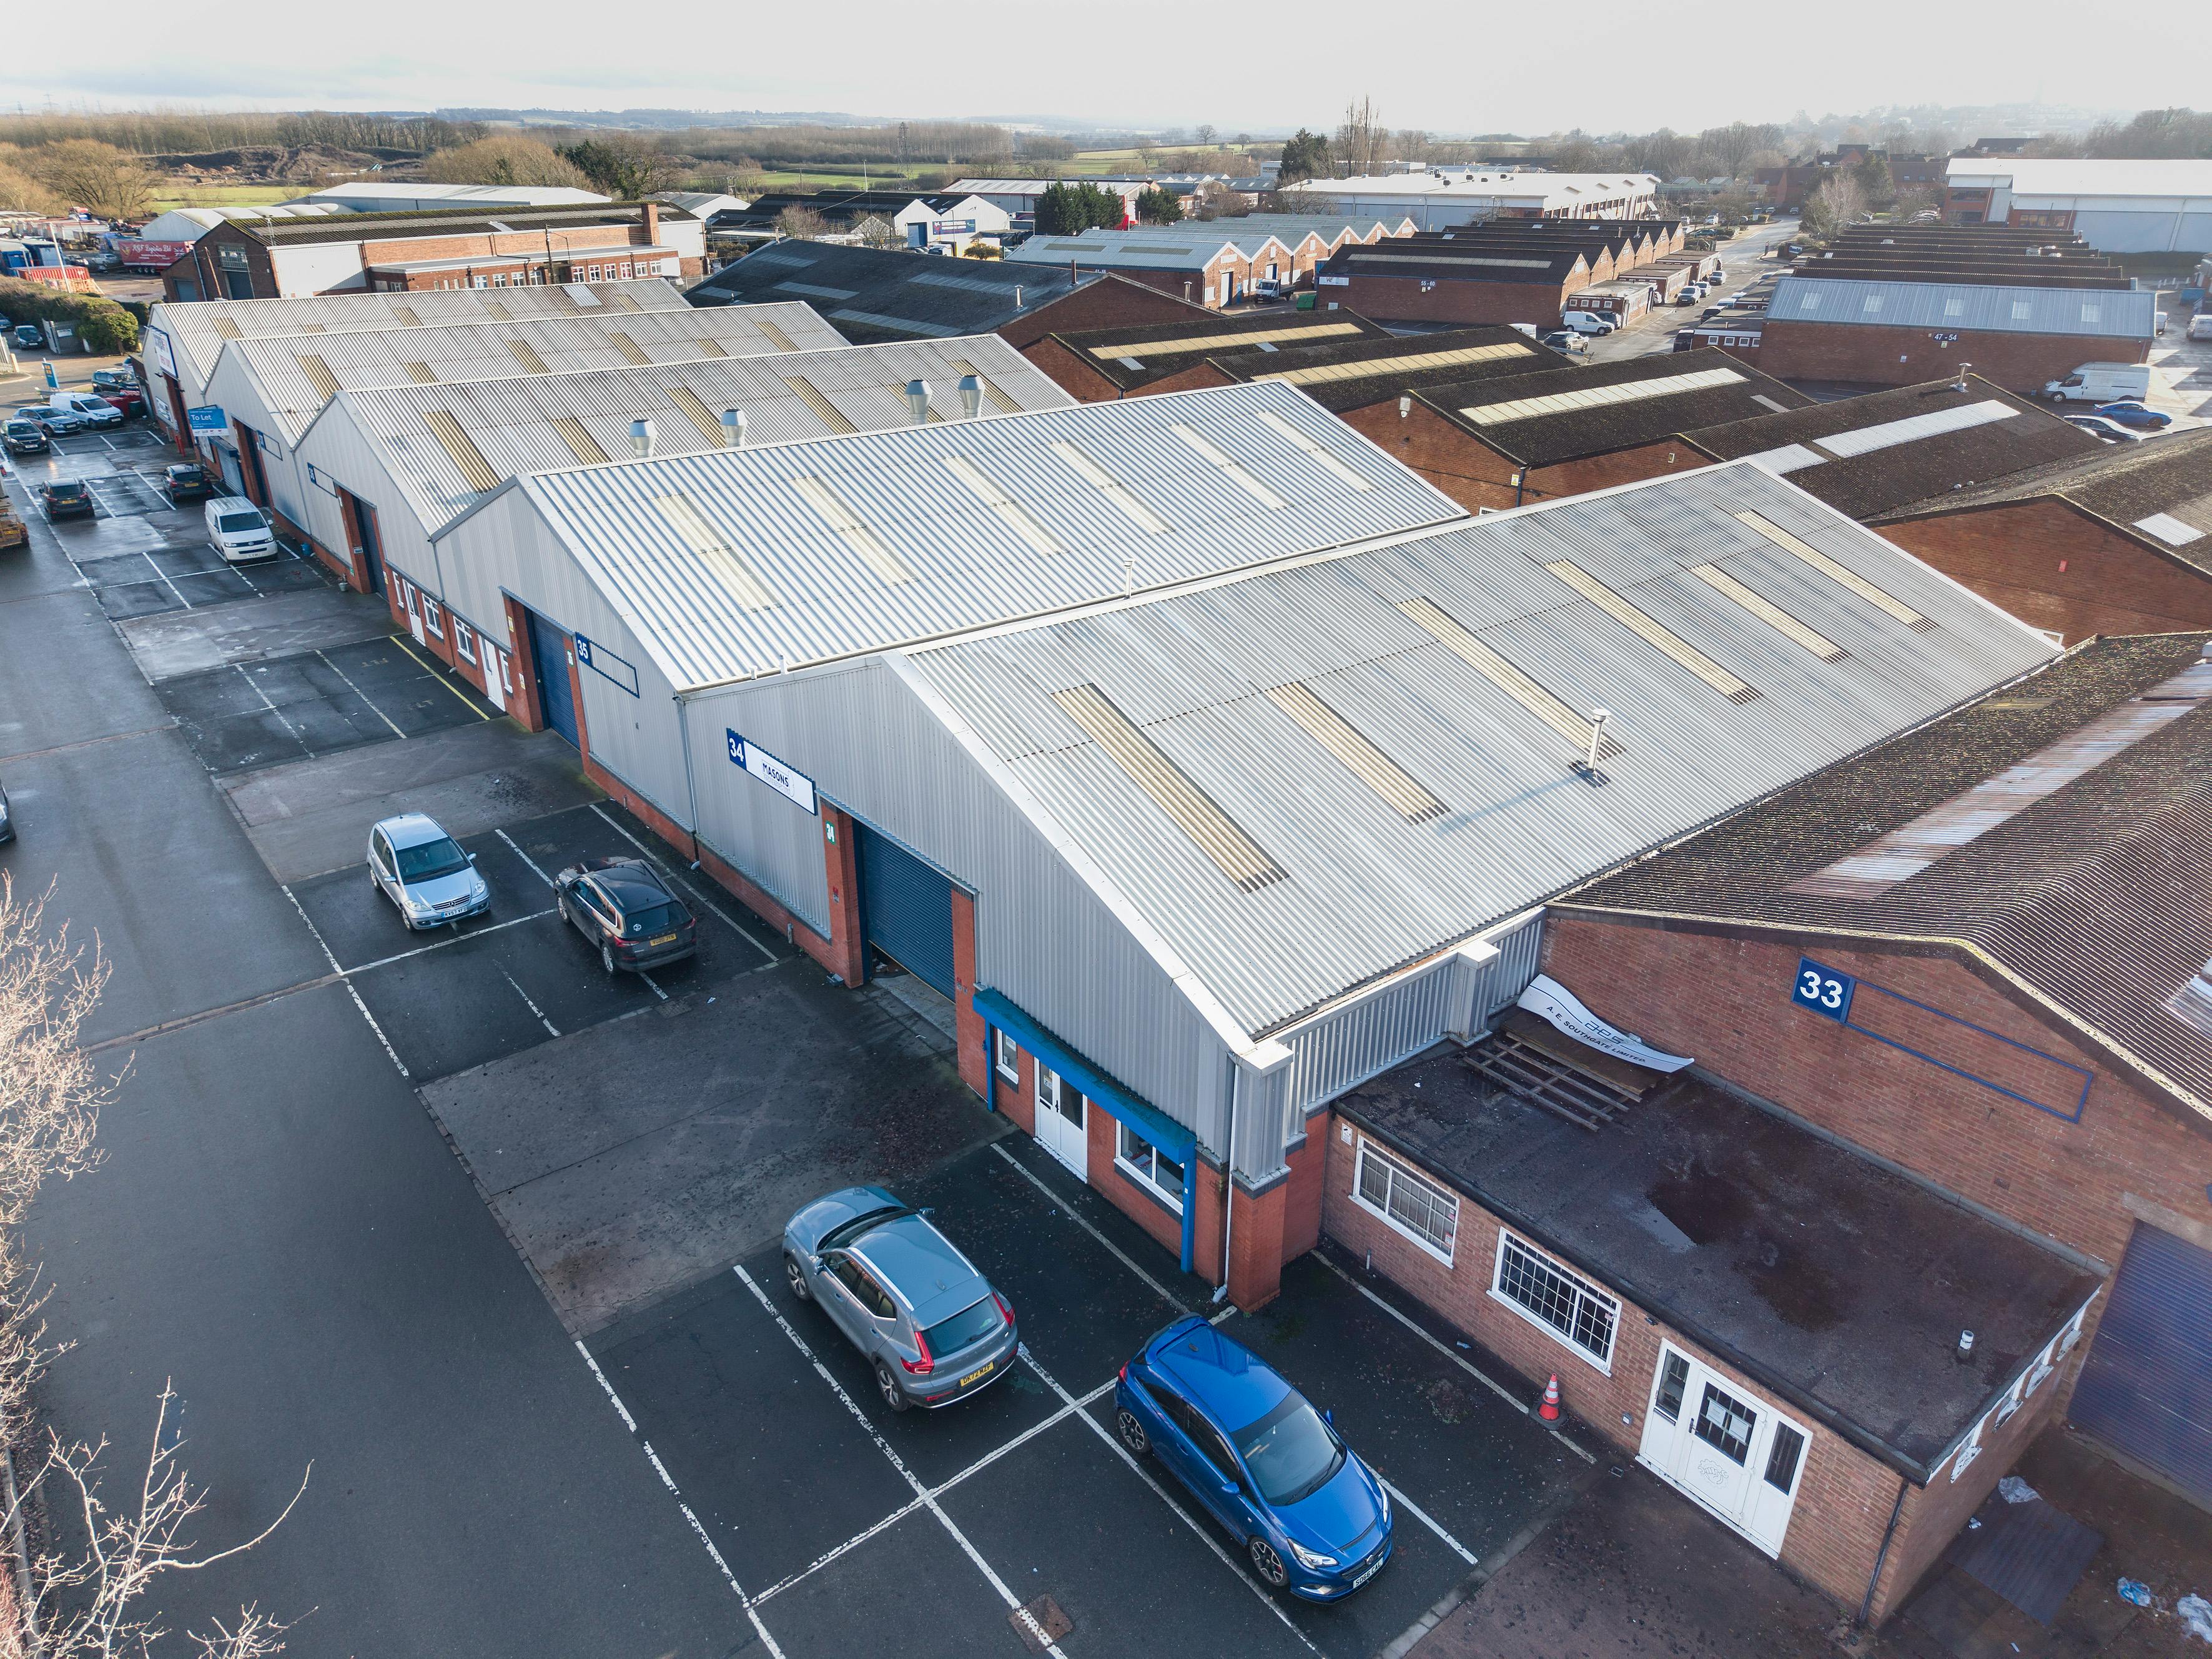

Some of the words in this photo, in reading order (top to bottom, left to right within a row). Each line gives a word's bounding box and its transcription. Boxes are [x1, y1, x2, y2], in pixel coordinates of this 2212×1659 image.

[578, 639, 588, 660] 35
[729, 738, 744, 762] 34
[763, 763, 789, 787] MASONS
[826, 823, 835, 843] 34
[1800, 971, 1842, 1008] 33
[1555, 1013, 1563, 1021] E.
[1564, 1021, 1611, 1049] SOUTHGATE
[964, 1372, 980, 1384] DK72
[1371, 1562, 1381, 1573] CAL
